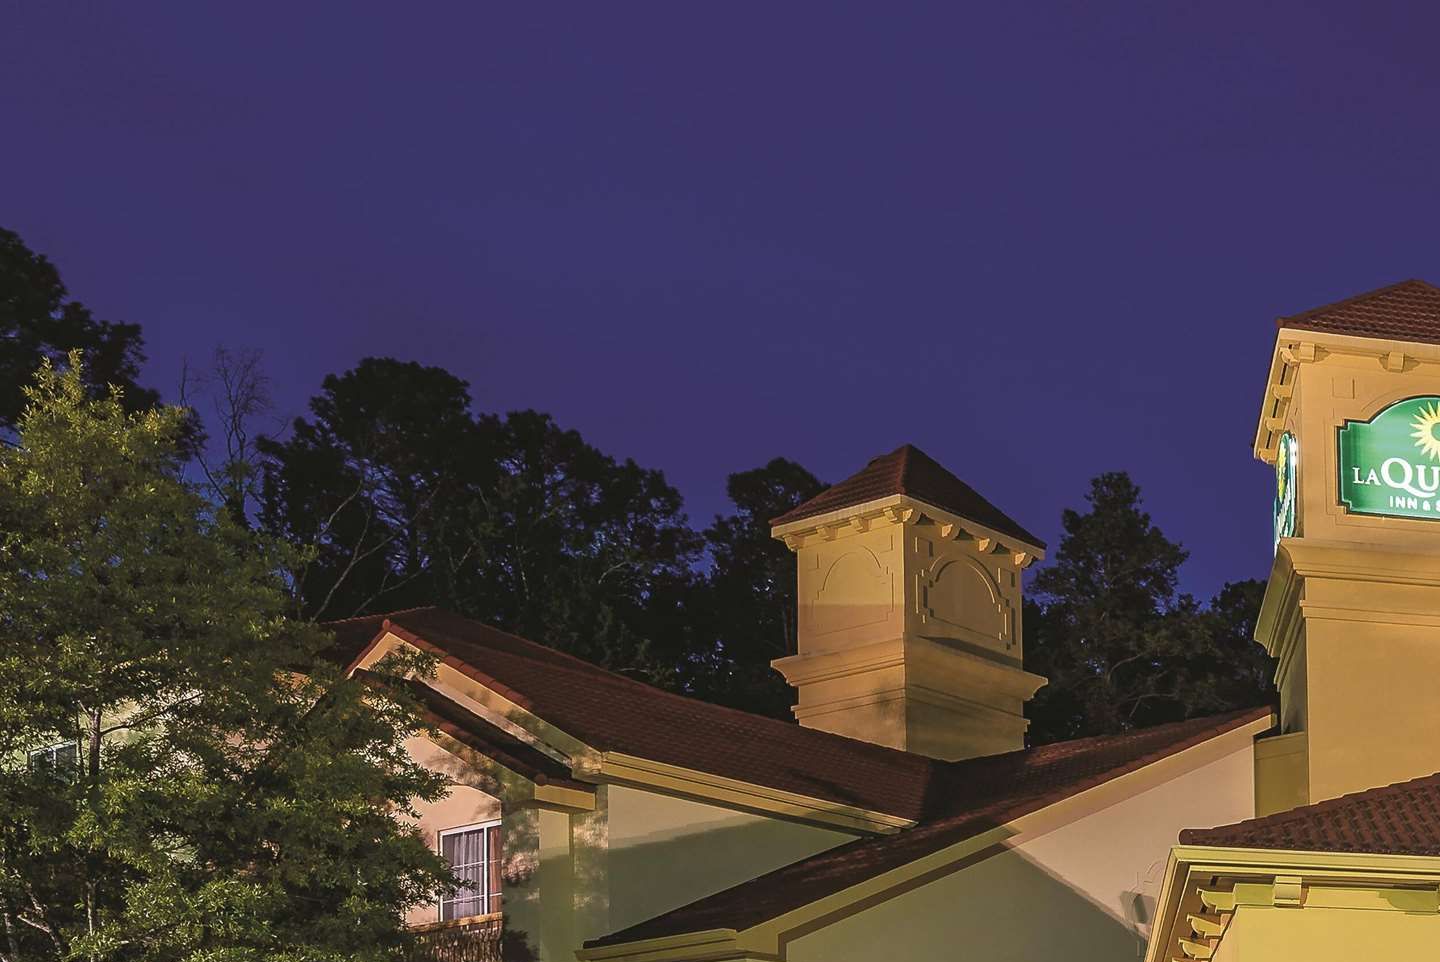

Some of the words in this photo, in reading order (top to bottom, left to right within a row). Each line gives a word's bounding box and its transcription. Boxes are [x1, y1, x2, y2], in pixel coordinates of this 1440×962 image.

[1352, 467, 1381, 486] LA
[1389, 495, 1418, 510] INN
[1422, 501, 1431, 512] &
